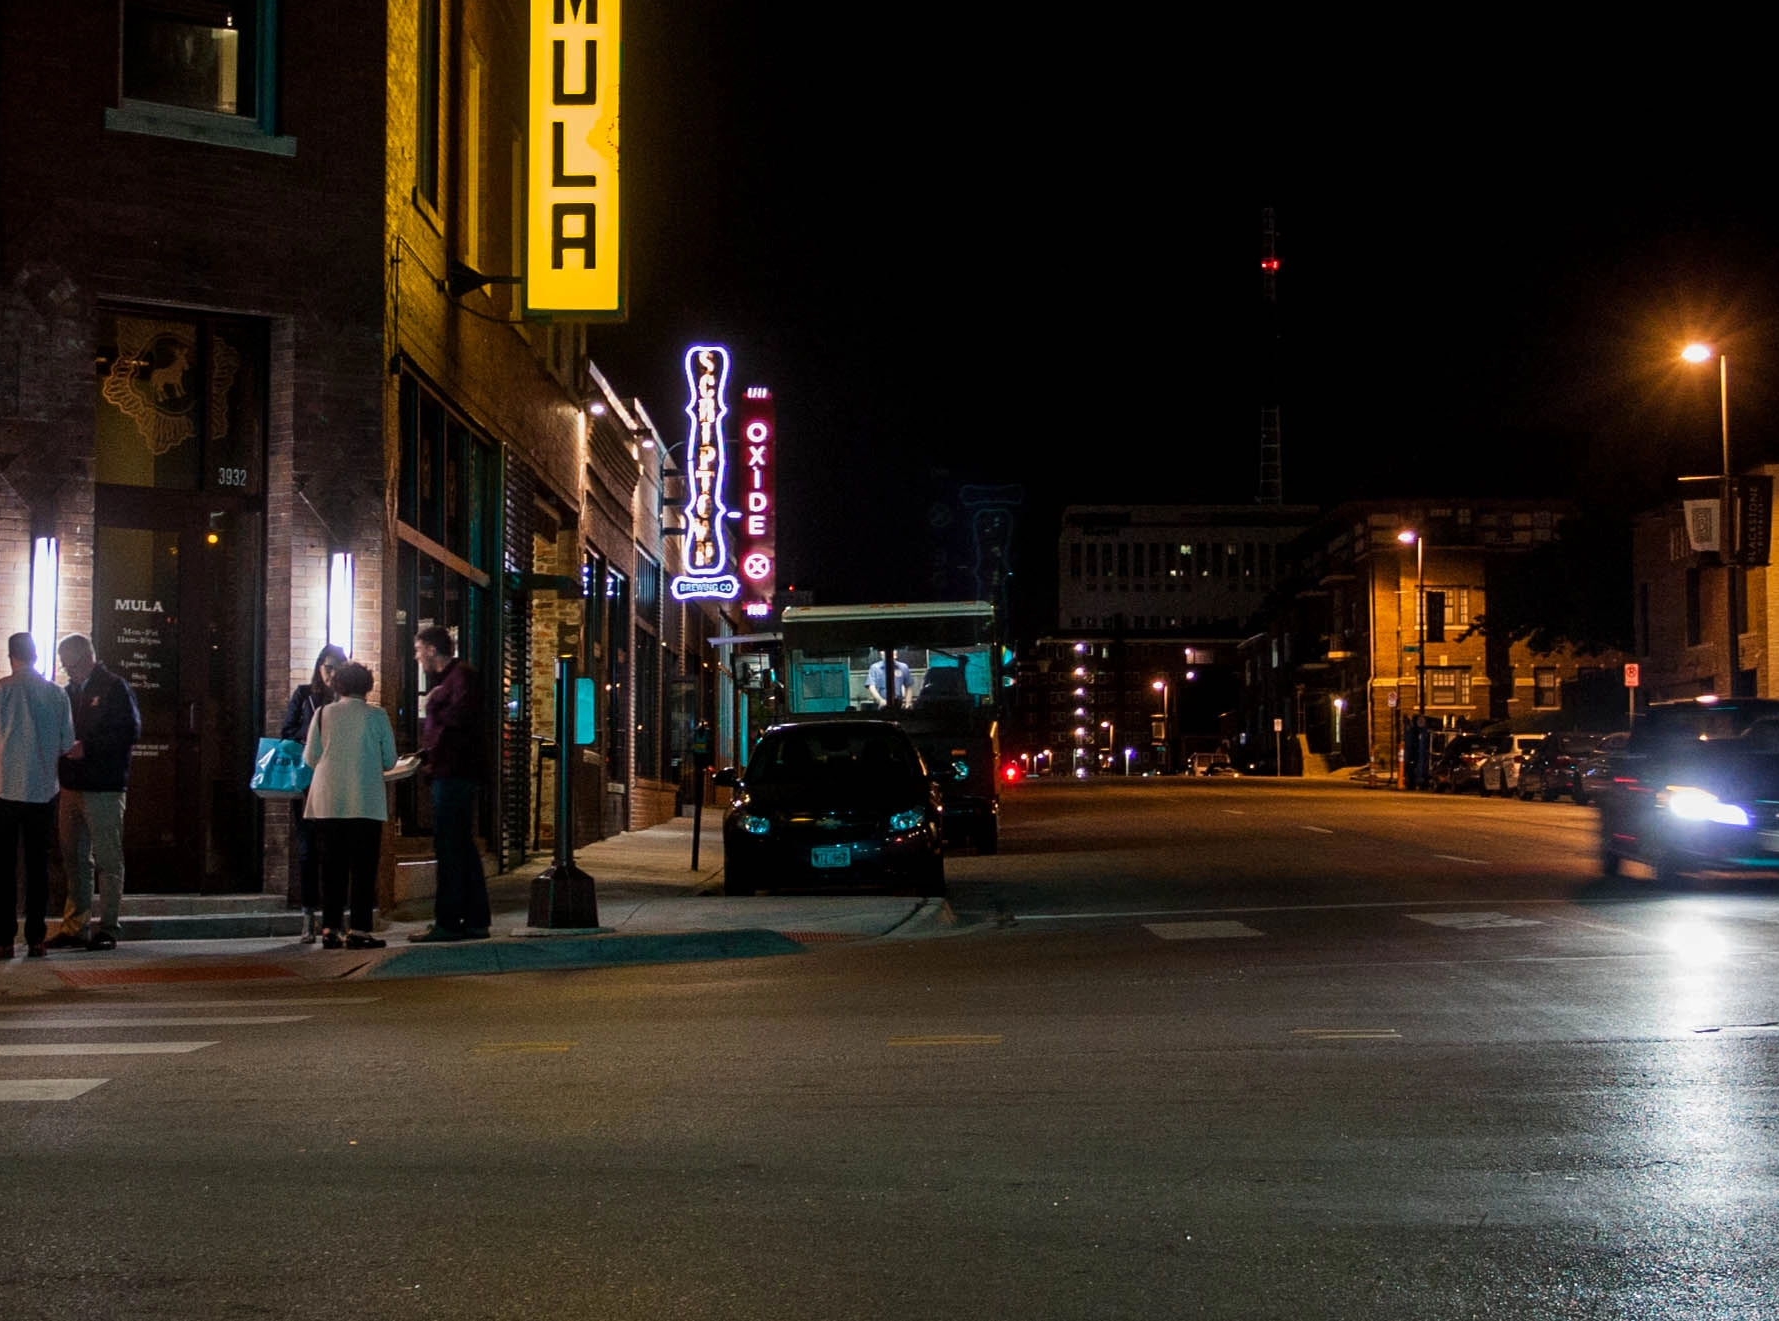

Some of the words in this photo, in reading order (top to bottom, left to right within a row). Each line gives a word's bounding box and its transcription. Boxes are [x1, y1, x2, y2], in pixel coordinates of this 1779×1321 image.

[218, 467, 247, 487] 3932
[746, 422, 768, 536] OXIDE
[680, 583, 718, 592] BREWING
[719, 583, 732, 592] CO
[114, 598, 164, 613] MULA
